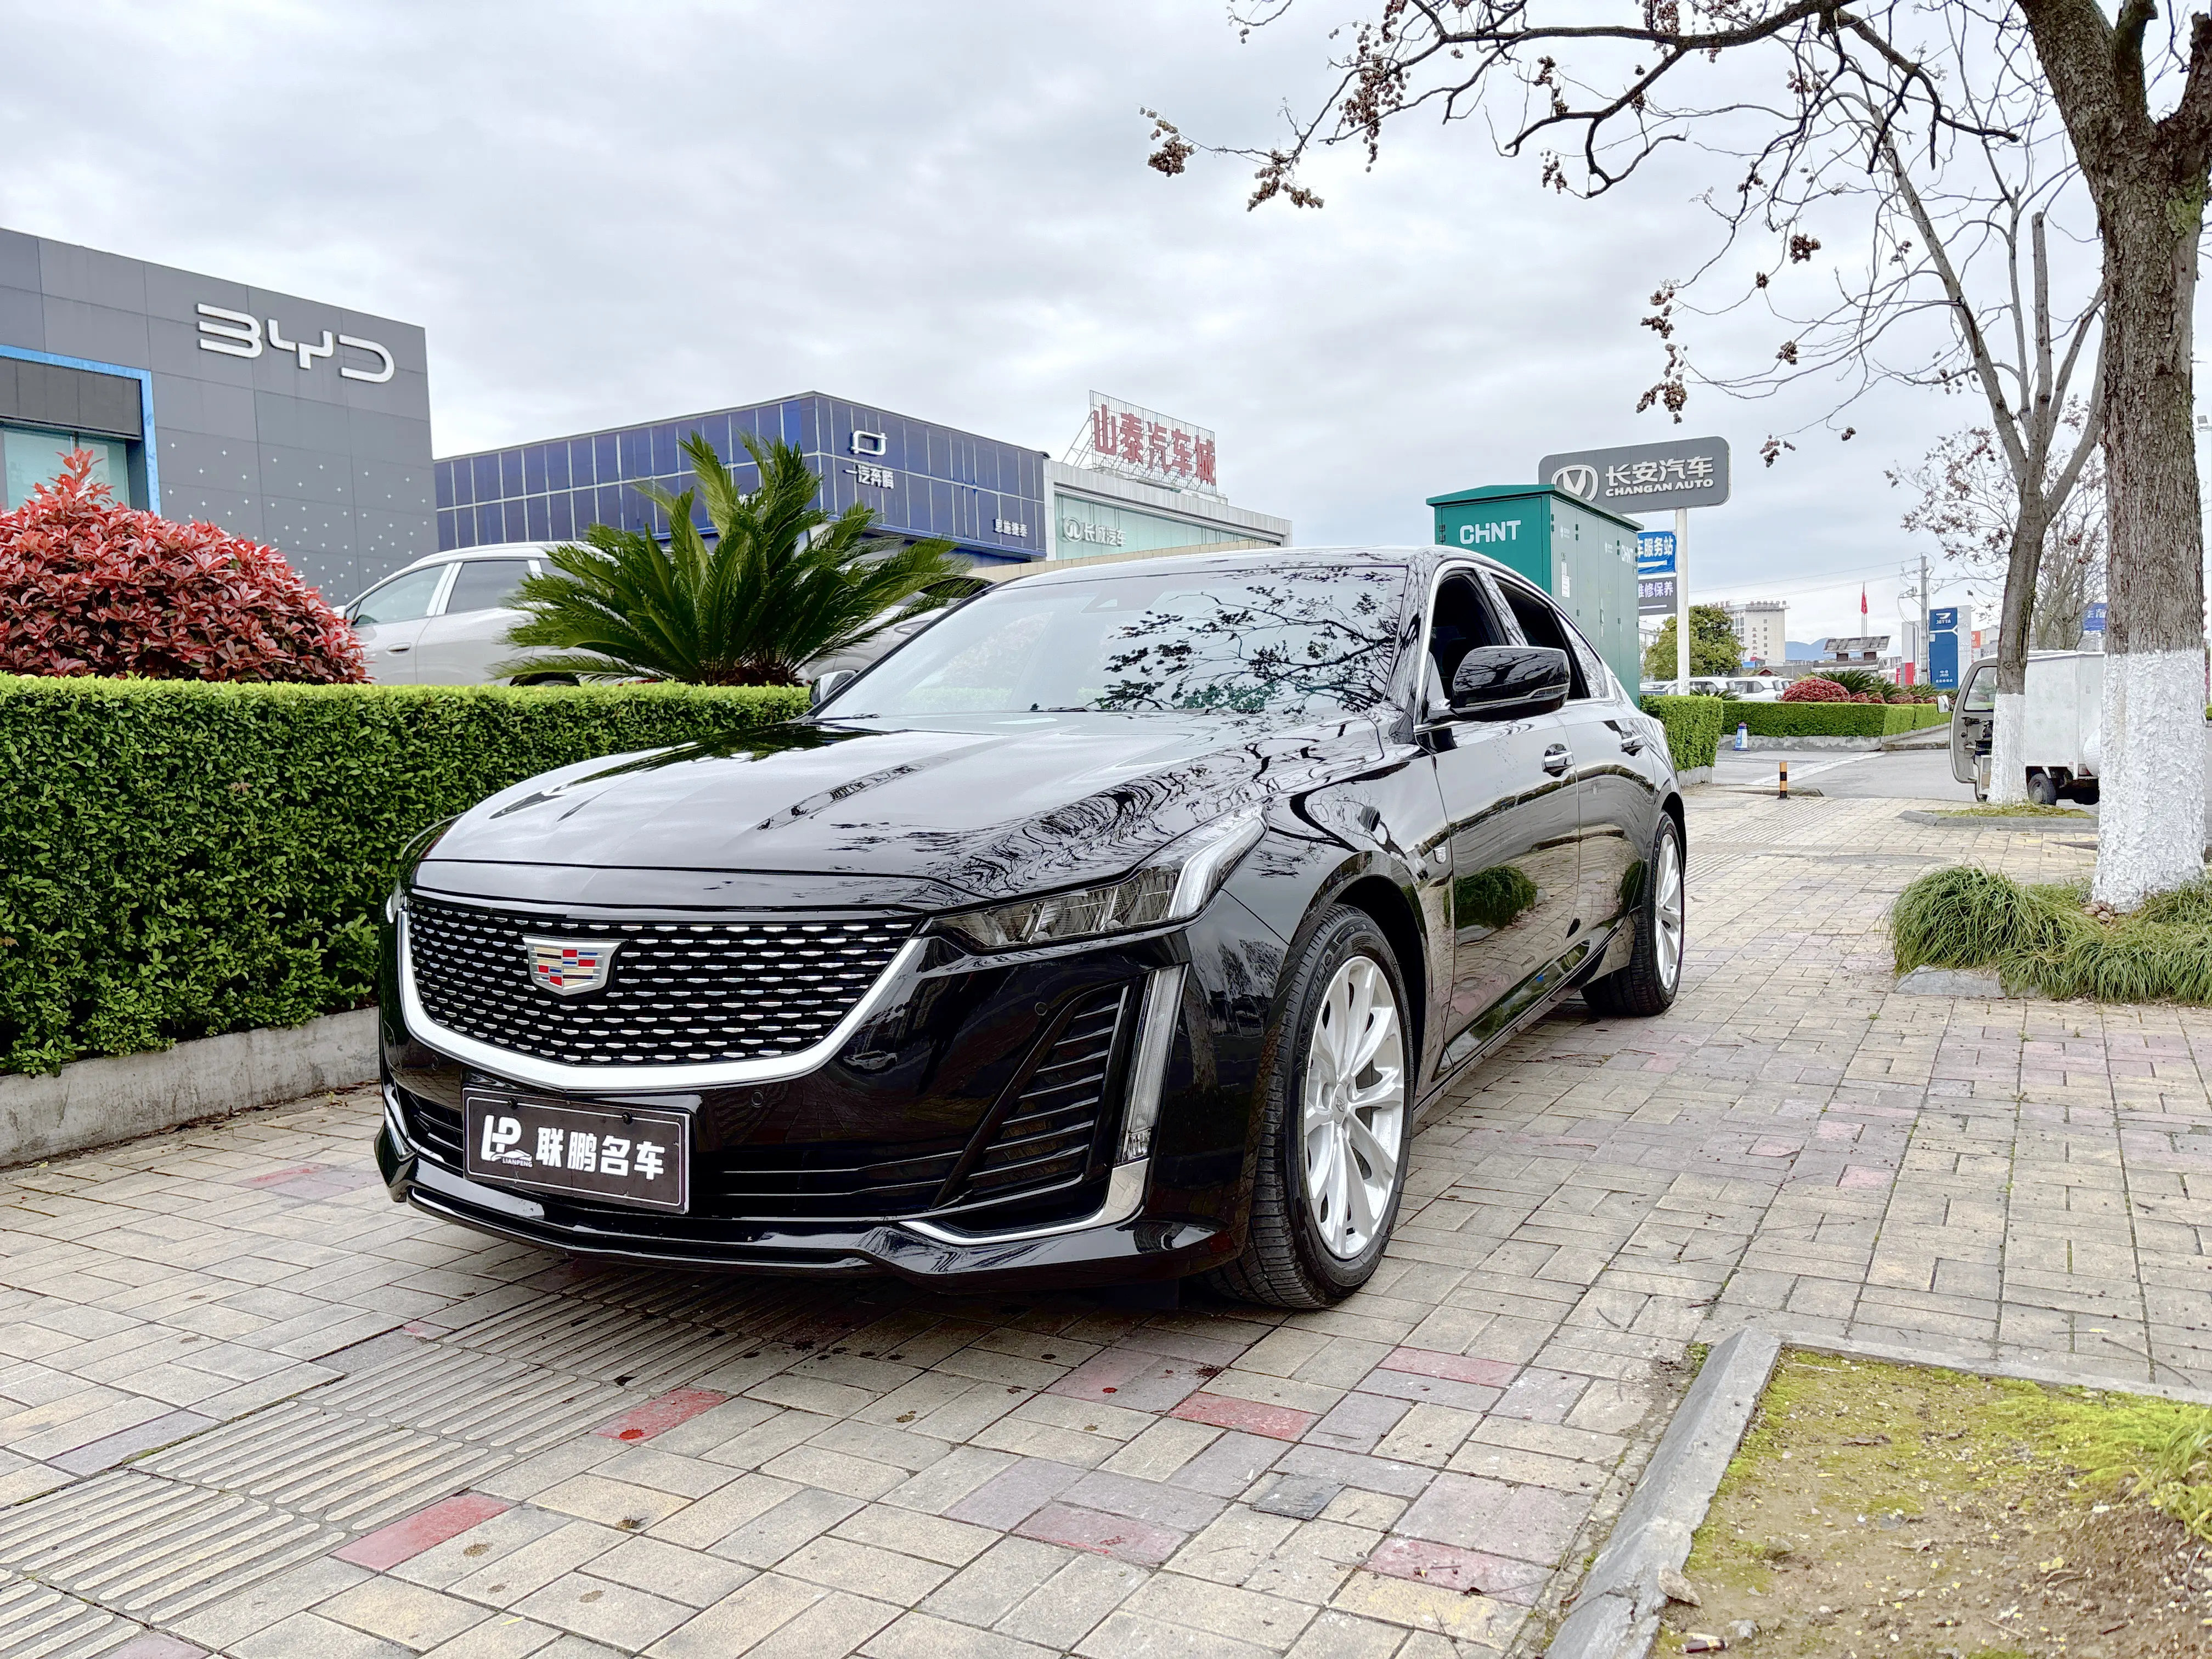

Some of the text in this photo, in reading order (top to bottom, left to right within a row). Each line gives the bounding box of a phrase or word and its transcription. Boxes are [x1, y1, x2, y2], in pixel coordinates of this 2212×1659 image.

[198, 303, 395, 383] BYD
[1093, 403, 1216, 486] 山泰汽车城
[1605, 455, 1714, 487] 长安汽车
[1605, 478, 1714, 497] CHANGAN AUTO
[502, 1157, 533, 1168] LIANPENG
[535, 1126, 665, 1181] 联鹏名车
